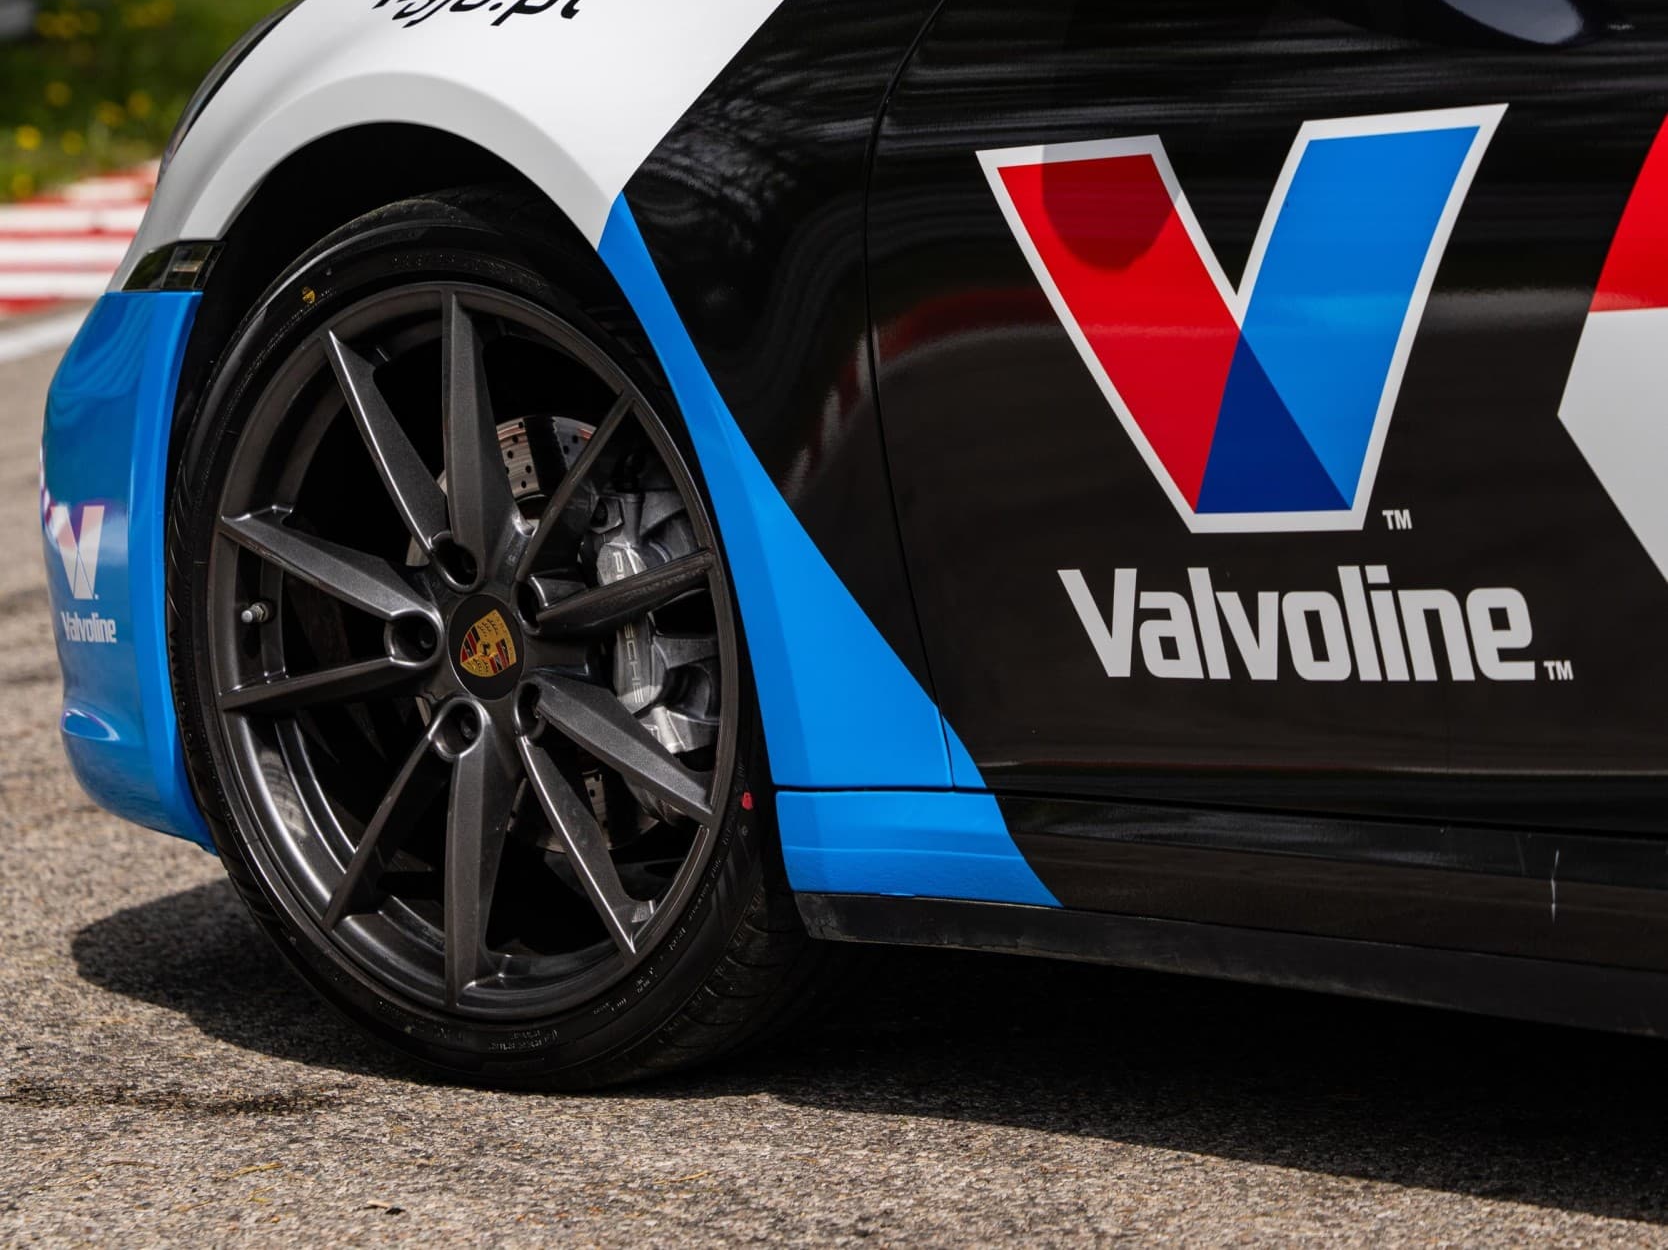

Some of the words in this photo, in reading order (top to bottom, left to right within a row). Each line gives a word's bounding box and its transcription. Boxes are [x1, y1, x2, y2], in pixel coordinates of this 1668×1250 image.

[1382, 509, 1413, 531] TM
[60, 610, 118, 644] Valvoline
[1057, 564, 1536, 682] Valvoline
[1543, 660, 1574, 681] TM
